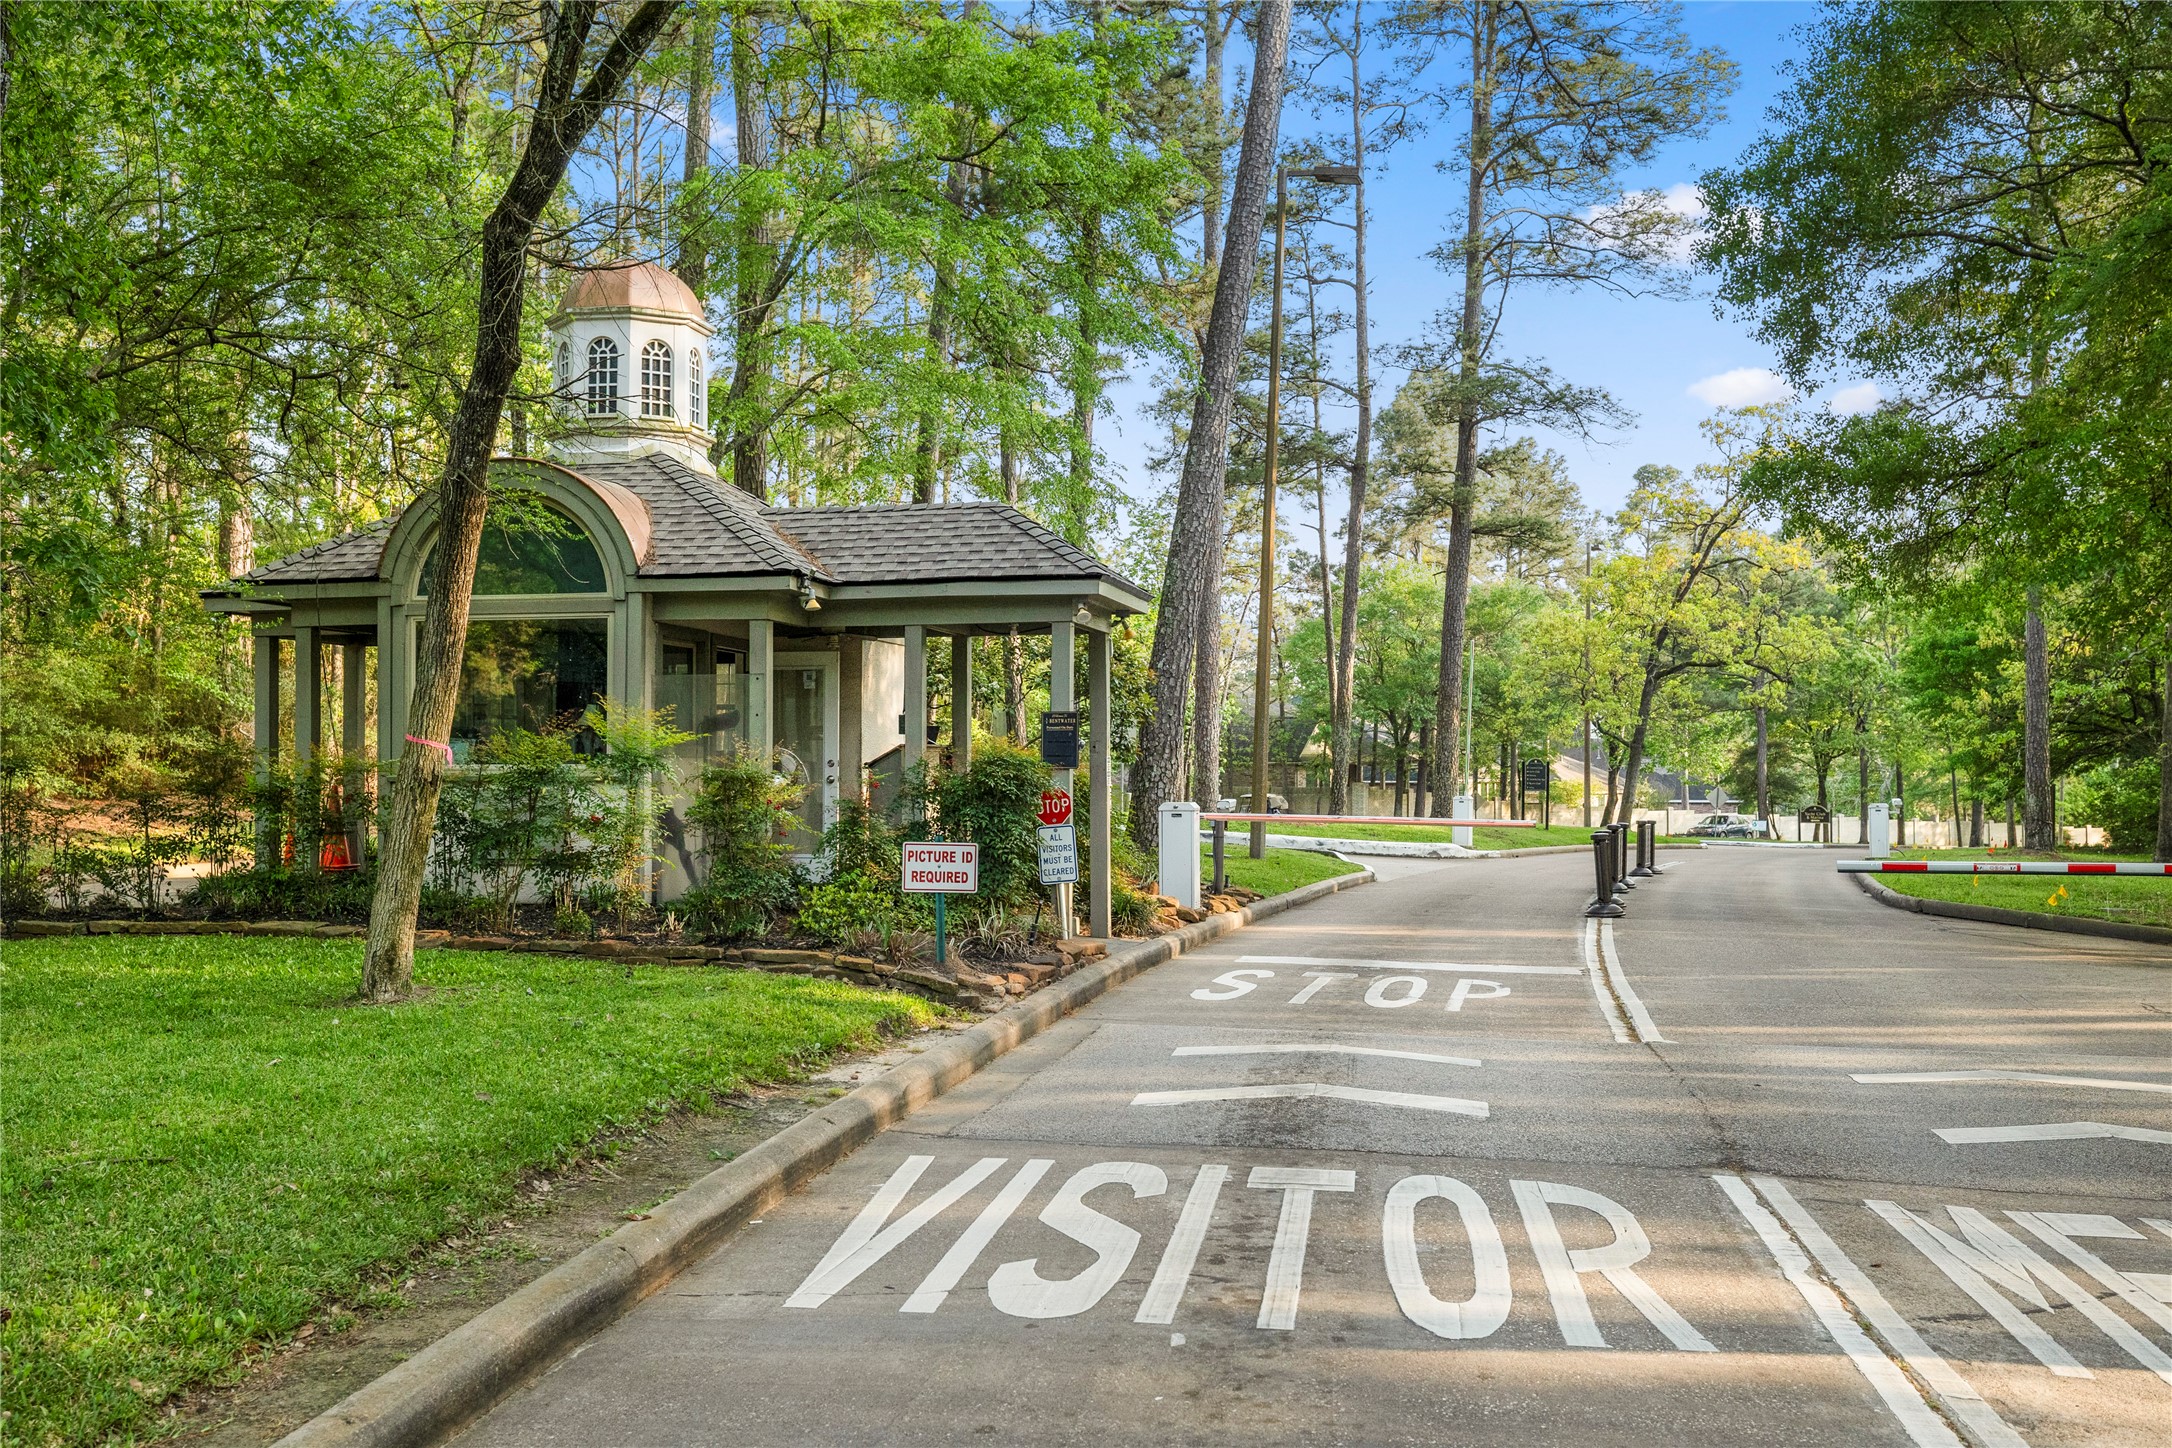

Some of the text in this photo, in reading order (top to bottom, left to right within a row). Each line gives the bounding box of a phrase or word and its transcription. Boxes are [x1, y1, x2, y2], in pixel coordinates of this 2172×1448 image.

[1042, 844, 1073, 853] VISITORS
[907, 850, 973, 864] PICTURE ID
[1043, 856, 1061, 865] MUST
[911, 870, 969, 884] REQUIRED
[1043, 867, 1075, 877] CLEARED
[1190, 969, 1512, 1012] STOP
[781, 1154, 1720, 1352] VISITOR
